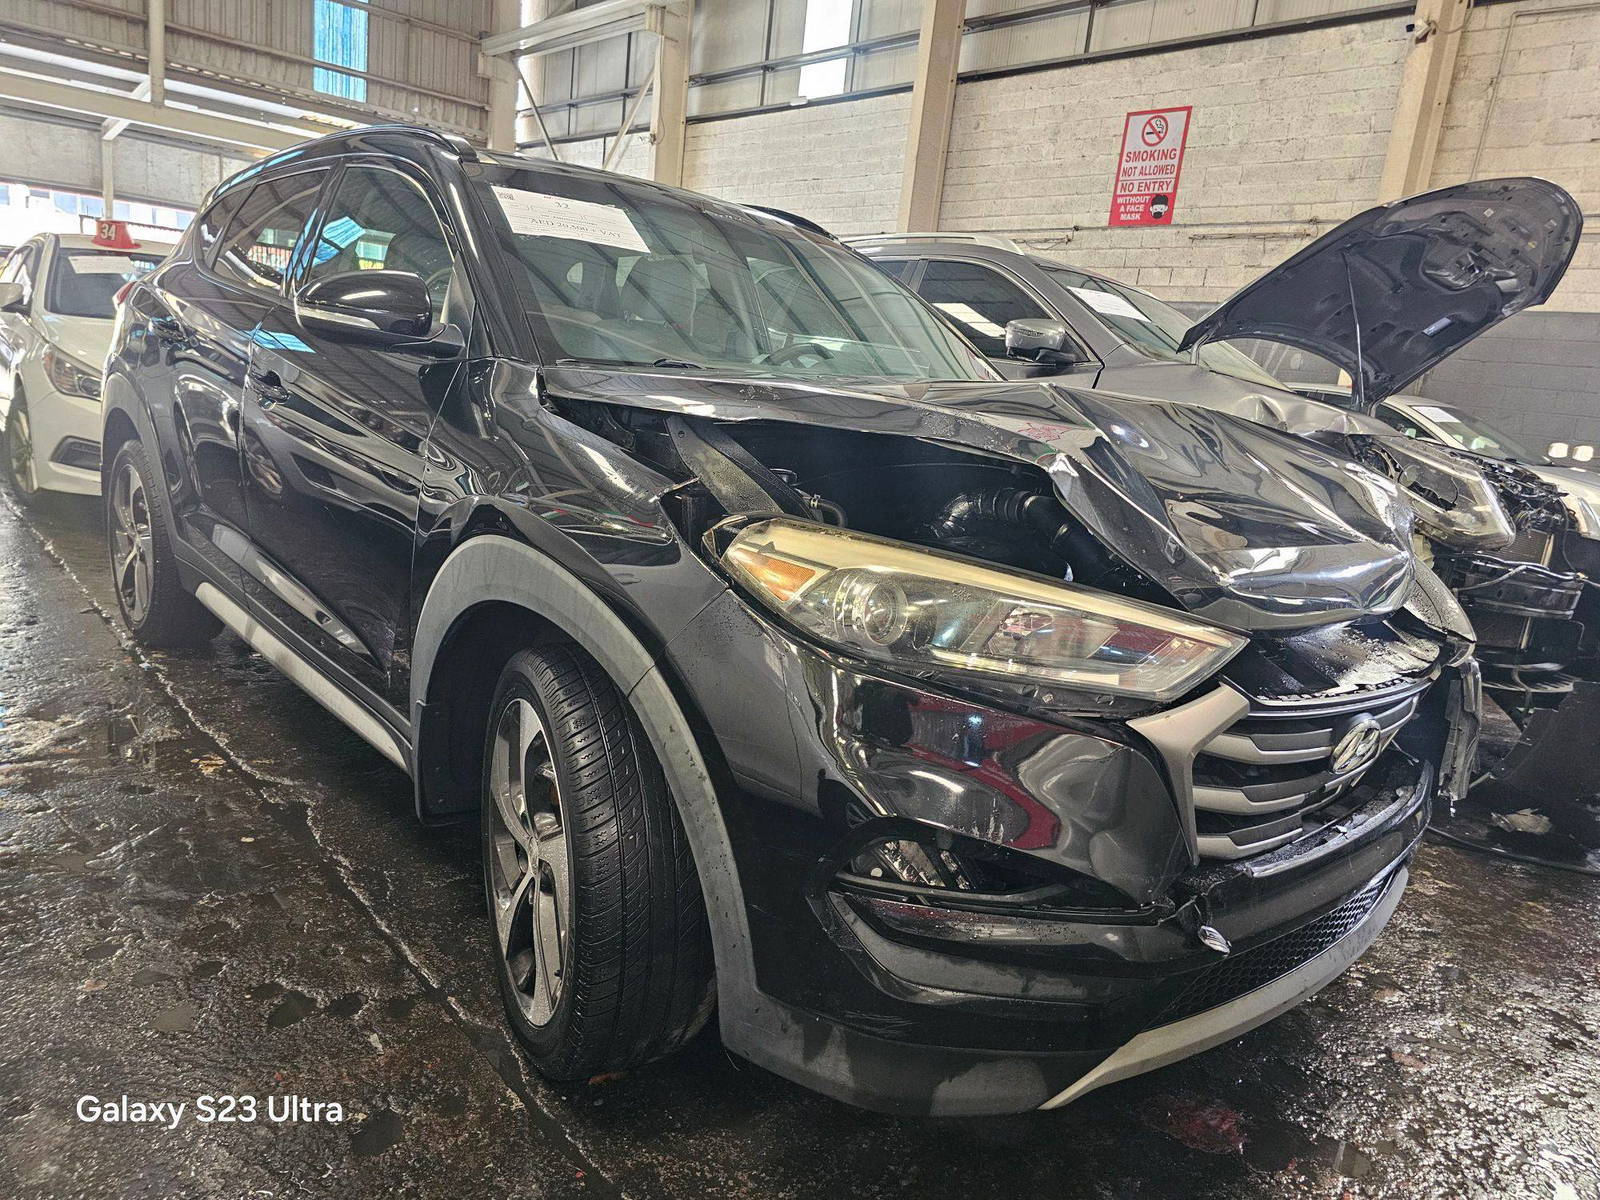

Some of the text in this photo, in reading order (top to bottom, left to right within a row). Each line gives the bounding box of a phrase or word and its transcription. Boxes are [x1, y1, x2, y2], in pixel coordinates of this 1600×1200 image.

[1125, 148, 1177, 163] SMOKING
[1122, 164, 1175, 177] NOT ALLOWED
[1120, 180, 1172, 192] NO ENTRY
[1117, 195, 1151, 204] WITHOUT
[1119, 204, 1145, 212] A FACE
[1120, 212, 1141, 220] MASK
[101, 224, 116, 240] 34
